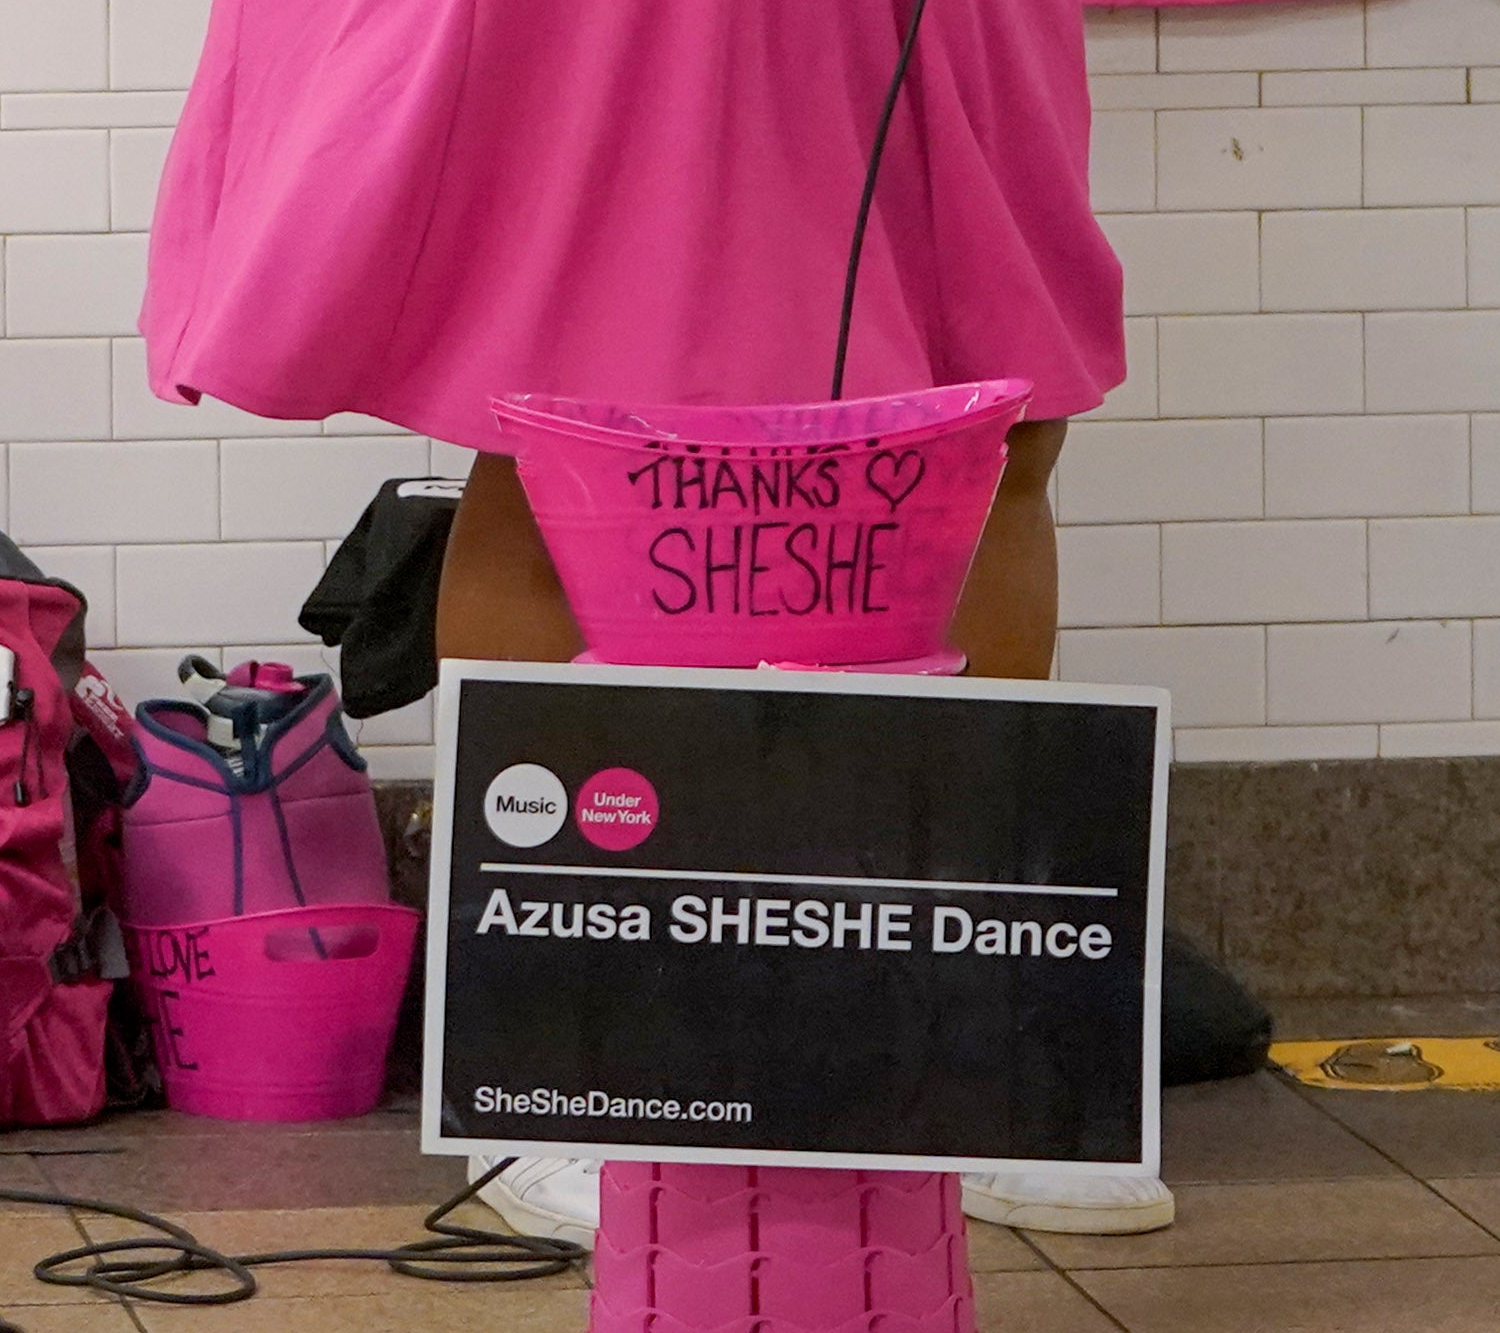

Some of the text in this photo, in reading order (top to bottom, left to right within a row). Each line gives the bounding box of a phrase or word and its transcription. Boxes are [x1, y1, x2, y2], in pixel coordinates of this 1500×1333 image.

[627, 454, 842, 516] THANKS
[649, 521, 900, 617] SHESHE
[495, 796, 557, 815] Music
[581, 809, 652, 825] New York
[594, 792, 642, 808] Under
[476, 888, 1114, 961] Azusa SHESHE Dance
[473, 1085, 754, 1125] SheSheDance.com
